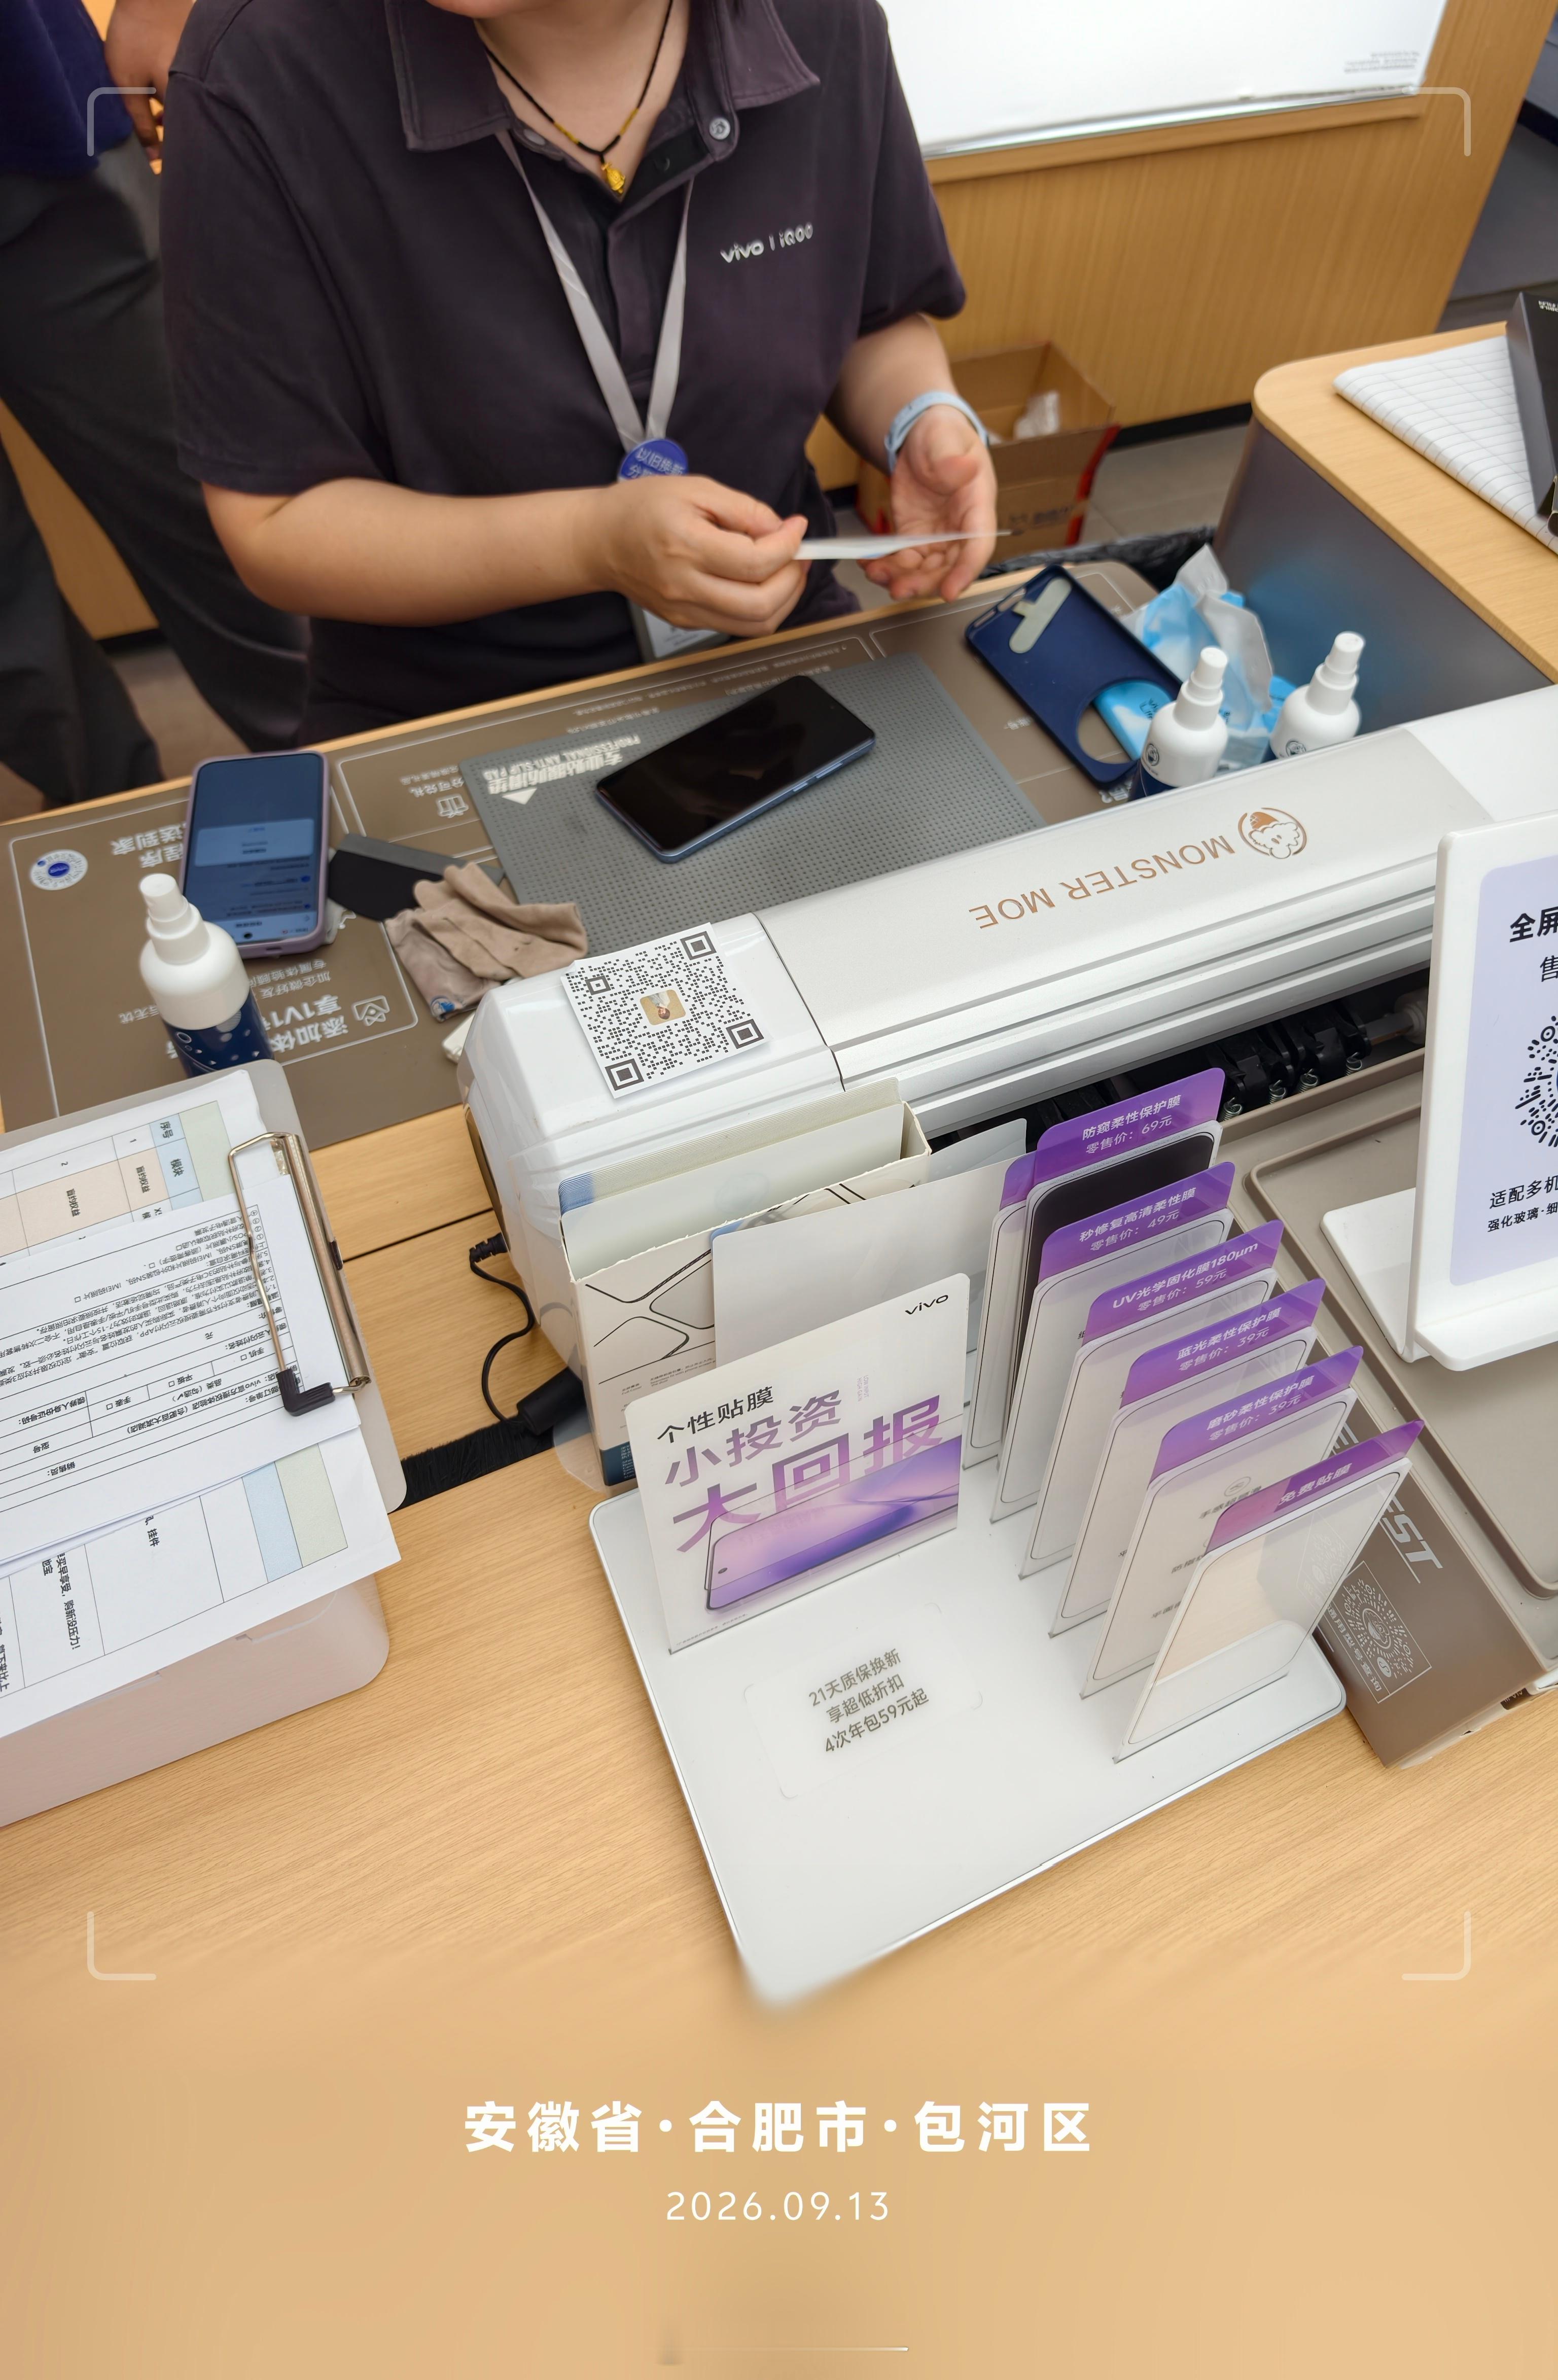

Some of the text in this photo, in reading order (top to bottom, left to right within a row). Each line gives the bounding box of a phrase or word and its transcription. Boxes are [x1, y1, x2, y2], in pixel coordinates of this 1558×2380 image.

[721, 239, 764, 263] vivo
[969, 835, 1235, 930] MONSTER MOE
[158, 1120, 174, 1140] 序号
[1082, 1094, 1182, 1140] 防窥柔性保护膜
[1085, 1115, 1172, 1155] 零售价：69元
[169, 1157, 186, 1177] 模块
[1079, 1187, 1197, 1244] 秒修复高清柔性膜
[1090, 1209, 1179, 1251] 零售价：49元
[905, 1293, 949, 1315] vivo
[1138, 1269, 1227, 1312] 零售价：59元
[203, 1331, 214, 1341] 元
[247, 1346, 265, 1358] 手机
[1177, 1307, 1281, 1361] 蓝光柔性保护膜
[1178, 1328, 1269, 1372] 零售价：39元
[175, 1373, 194, 1385] 平板
[17, 1395, 86, 1426] 领券人身份证号码：
[114, 1395, 132, 1408] 手表
[657, 1386, 774, 1444] 个性贴膜
[1206, 1376, 1315, 1432] 磨砂柔性保护膜
[1209, 1394, 1302, 1443] 零售价：39元
[31, 1441, 51, 1454] 型号
[665, 1390, 841, 1487] 小投资
[45, 1460, 77, 1478] 销售员：
[674, 1394, 942, 1553] 大回报
[1278, 1463, 1353, 1507] 免费贴膜
[1325, 1604, 1382, 1692] 通用型号查询
[809, 1648, 902, 1707] 21天质保换新
[826, 1674, 905, 1724] 享超低折扣
[825, 1688, 930, 1754] 4次年包59元起
